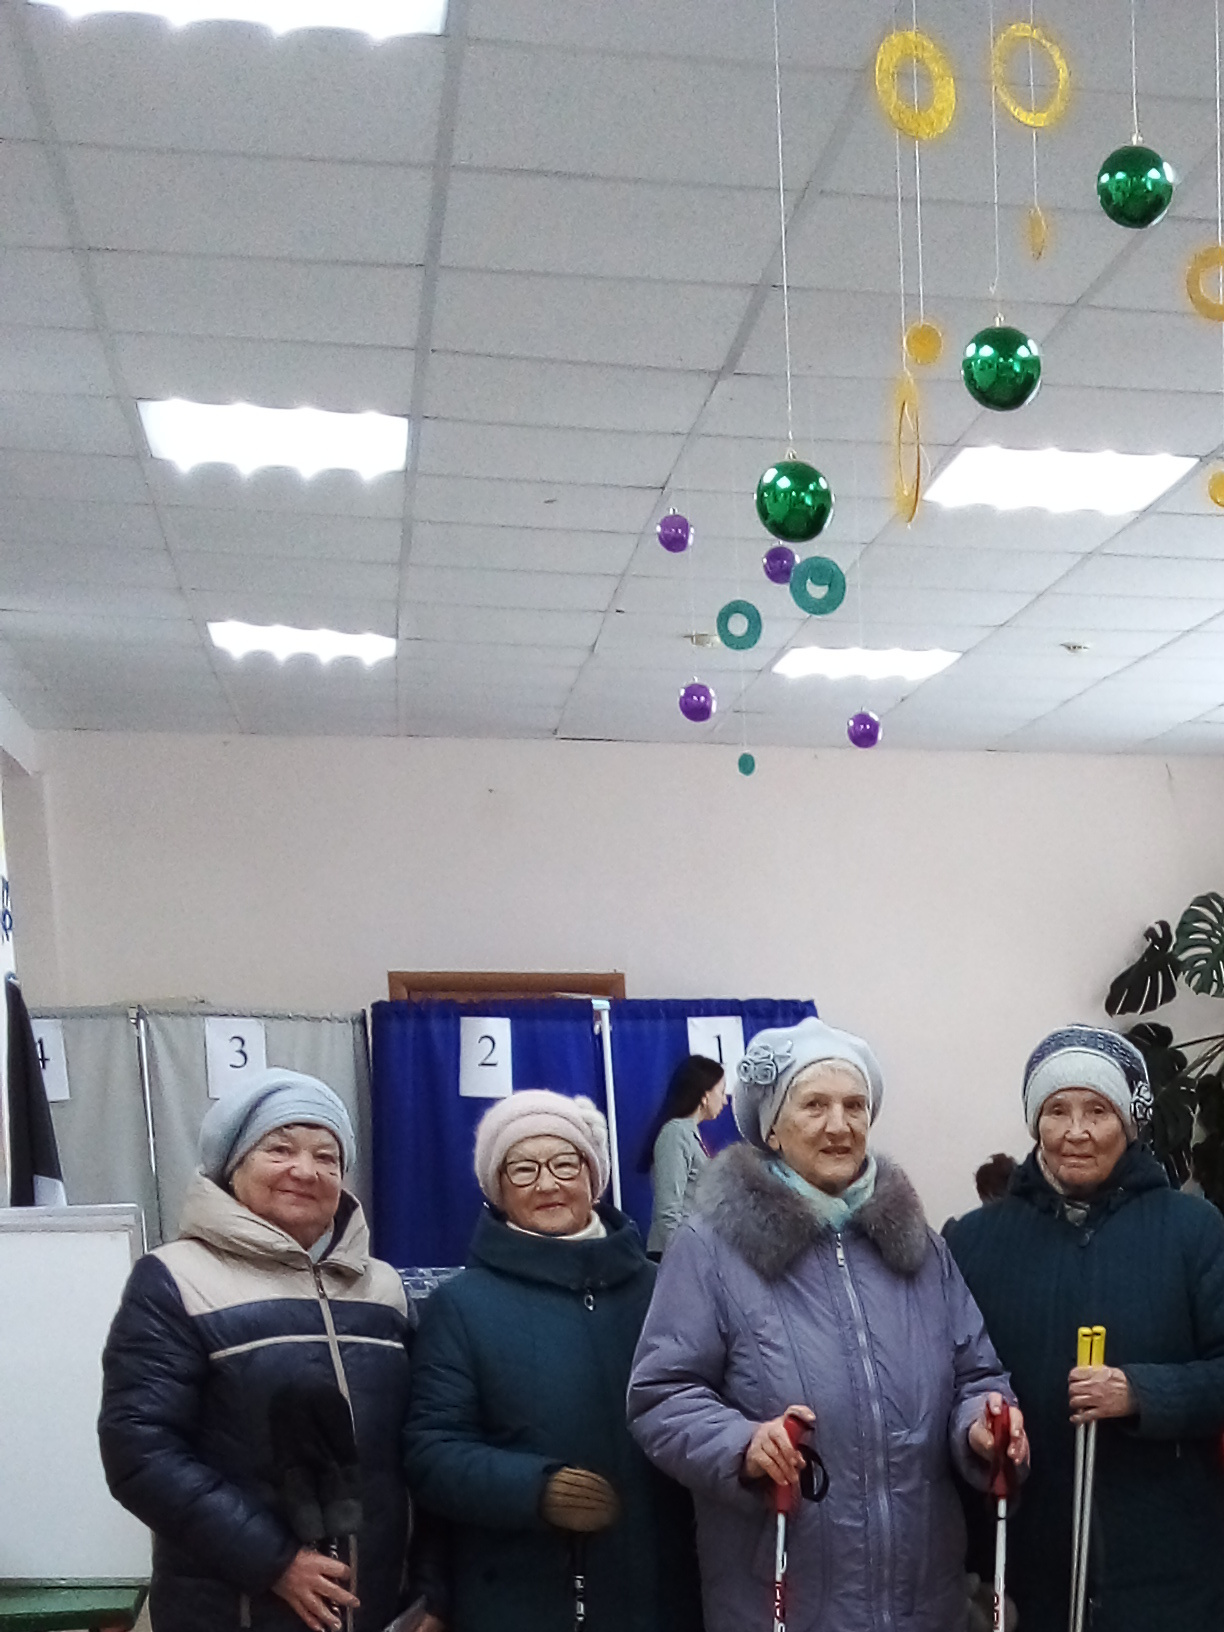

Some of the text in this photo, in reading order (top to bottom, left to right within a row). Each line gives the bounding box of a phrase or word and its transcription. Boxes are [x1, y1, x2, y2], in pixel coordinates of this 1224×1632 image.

[228, 1036, 248, 1068] 3
[477, 1035, 498, 1067] 2
[714, 1034, 724, 1064] 1
